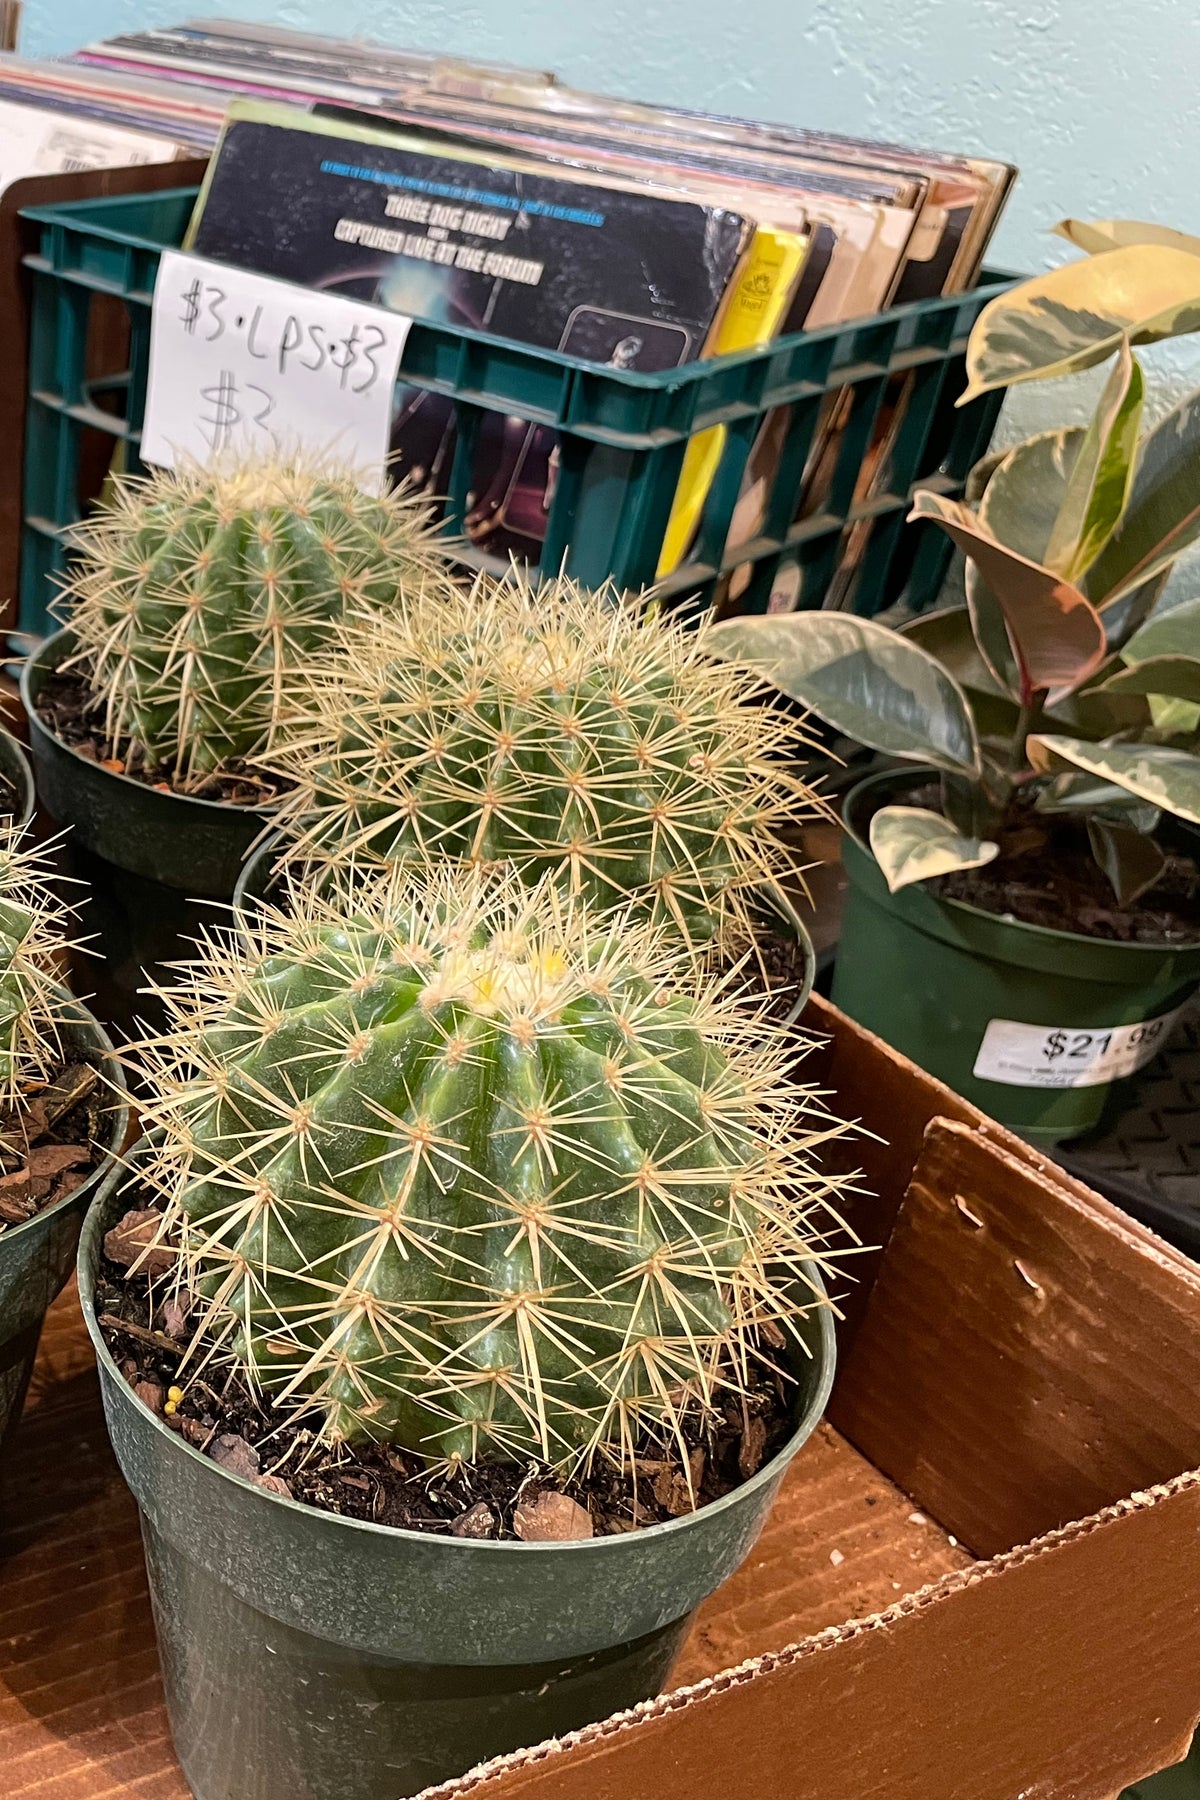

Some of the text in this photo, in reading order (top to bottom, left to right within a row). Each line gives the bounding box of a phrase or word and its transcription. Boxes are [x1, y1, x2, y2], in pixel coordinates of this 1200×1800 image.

[384, 194, 431, 224] THREE
[428, 204, 464, 231] DOG
[460, 209, 512, 241] NIGHT
[334, 218, 544, 286] CAPTURED LIVE AT THE FORUM
[1042, 1021, 1164, 1061] $21.99
